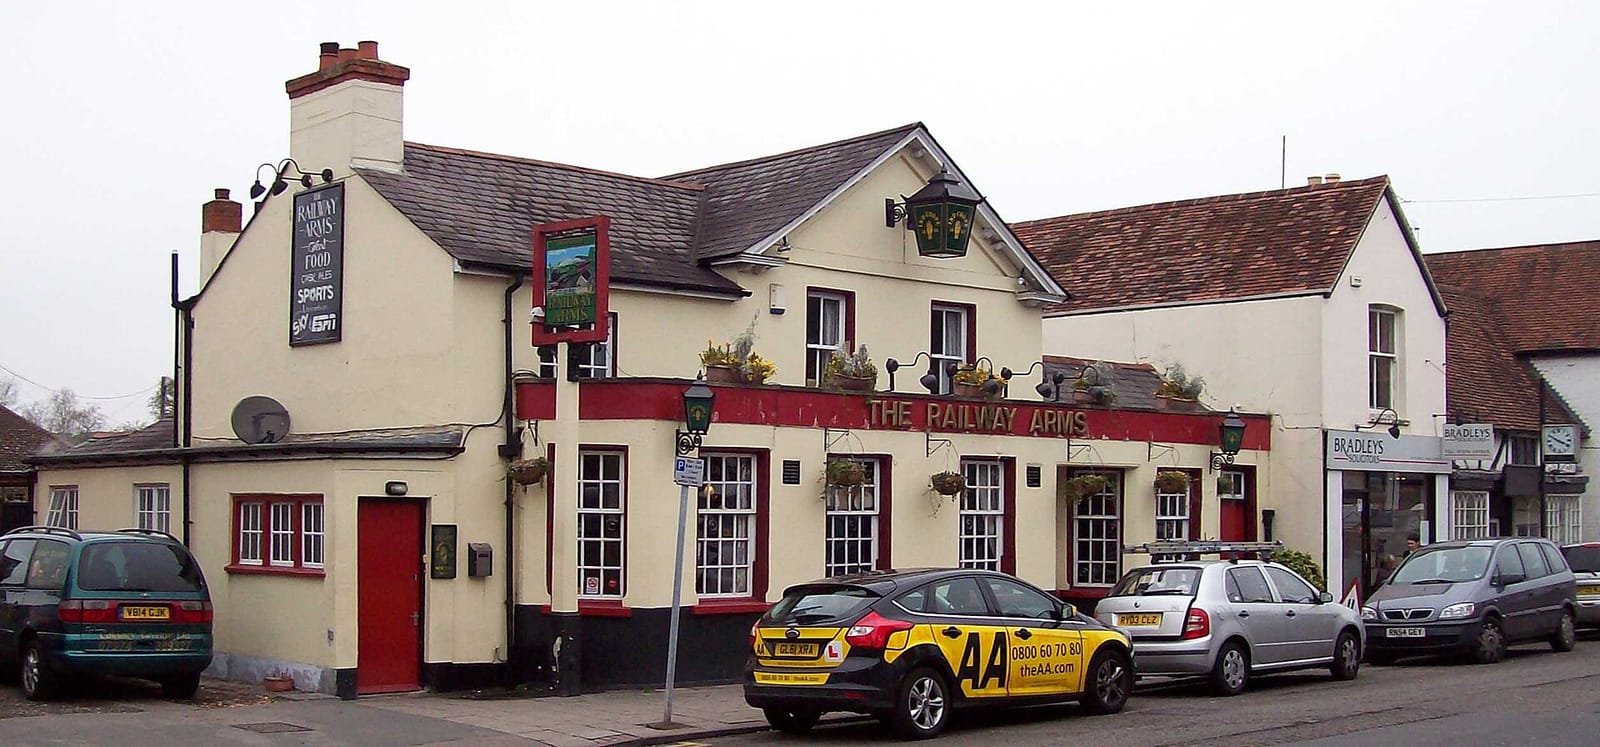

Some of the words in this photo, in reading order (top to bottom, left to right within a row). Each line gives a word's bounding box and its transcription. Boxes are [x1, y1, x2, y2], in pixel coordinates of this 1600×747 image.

[298, 198, 337, 222] RAILWAY
[306, 217, 333, 237] ARMS
[305, 251, 331, 270] FOOD
[297, 284, 334, 304] SPORTS
[870, 400, 913, 427] THE
[927, 402, 1018, 432] RAILWAY
[1029, 408, 1089, 434] ARMS
[1444, 428, 1490, 438] BRADLEYS
[1334, 437, 1384, 456] BRADLEYS
[1119, 615, 1139, 625] RY03
[1141, 615, 1158, 624] CLZ
[757, 644, 765, 655] AA
[798, 644, 814, 655] XRA
[828, 645, 838, 658] L
[1012, 646, 1036, 660] 0800
[1040, 644, 1052, 658] 60
[1055, 643, 1067, 656] 70
[1070, 641, 1081, 655] 80
[957, 631, 1006, 690] AA
[1019, 662, 1074, 677] theAA.com
